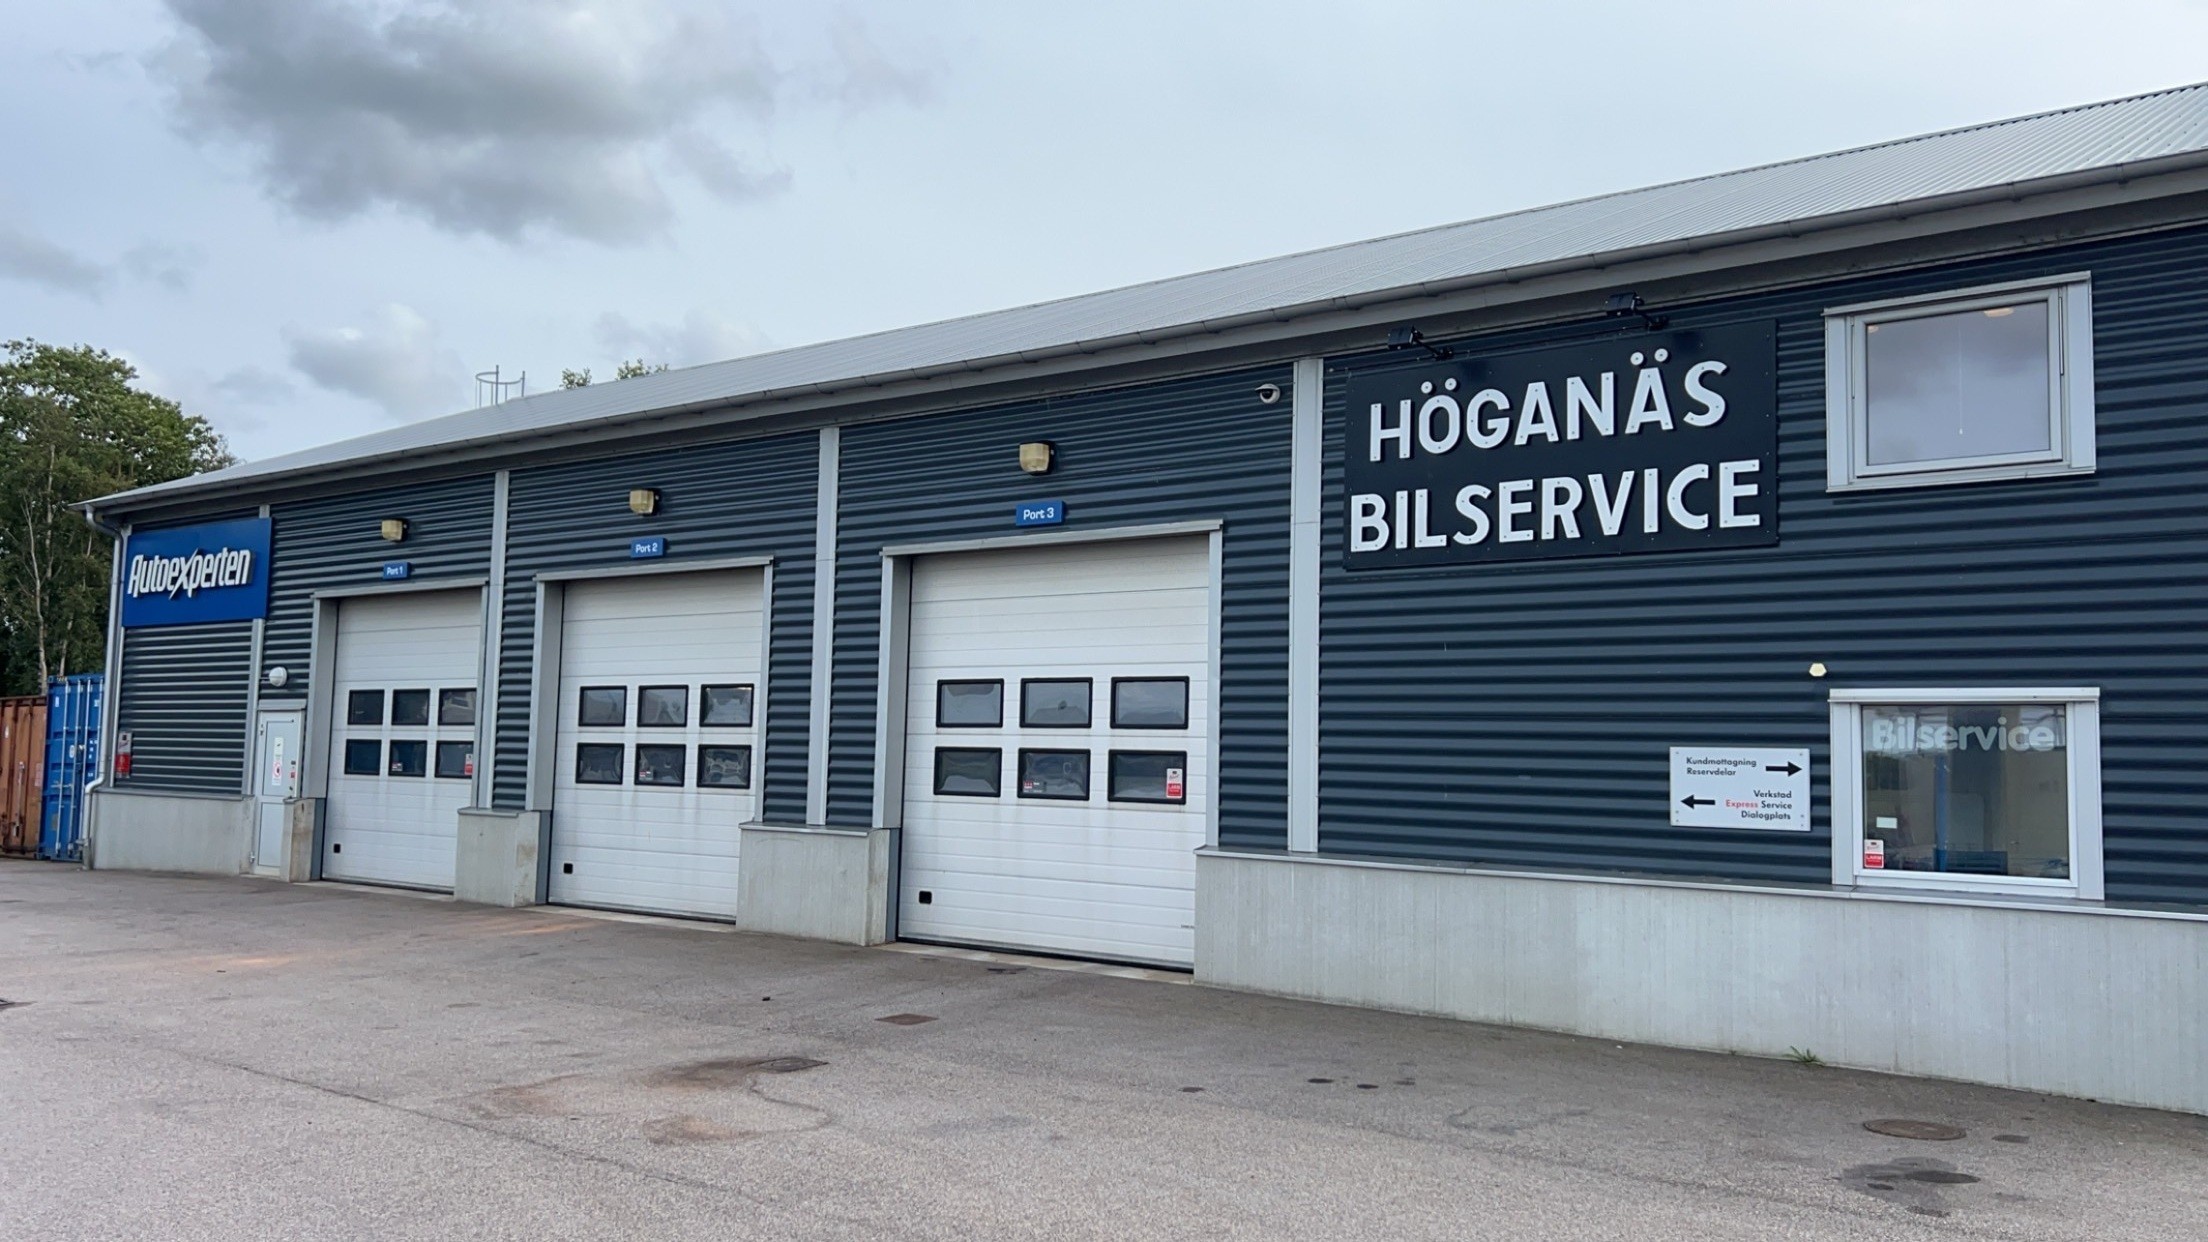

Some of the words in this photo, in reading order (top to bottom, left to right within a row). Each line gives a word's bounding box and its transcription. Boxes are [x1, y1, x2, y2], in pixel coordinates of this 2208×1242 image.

[1370, 348, 1728, 462] HÖGANÄS
[1350, 459, 1761, 553] BILSERVICE
[1023, 509, 1045, 520] Port
[1046, 507, 1054, 519] 3
[635, 544, 651, 553] Port
[652, 542, 658, 552] 2
[127, 547, 251, 600] Autoexperten
[386, 567, 398, 576] Port
[399, 566, 403, 575] 1
[1872, 716, 2056, 751] Bilservice
[1686, 757, 1757, 767] Kundmottagning
[1686, 768, 1736, 776] Reservdelar
[1753, 790, 1792, 798] Verkstad
[1725, 800, 1758, 809] Express
[1761, 801, 1792, 809] Service
[1741, 811, 1791, 821] Dialogplats
